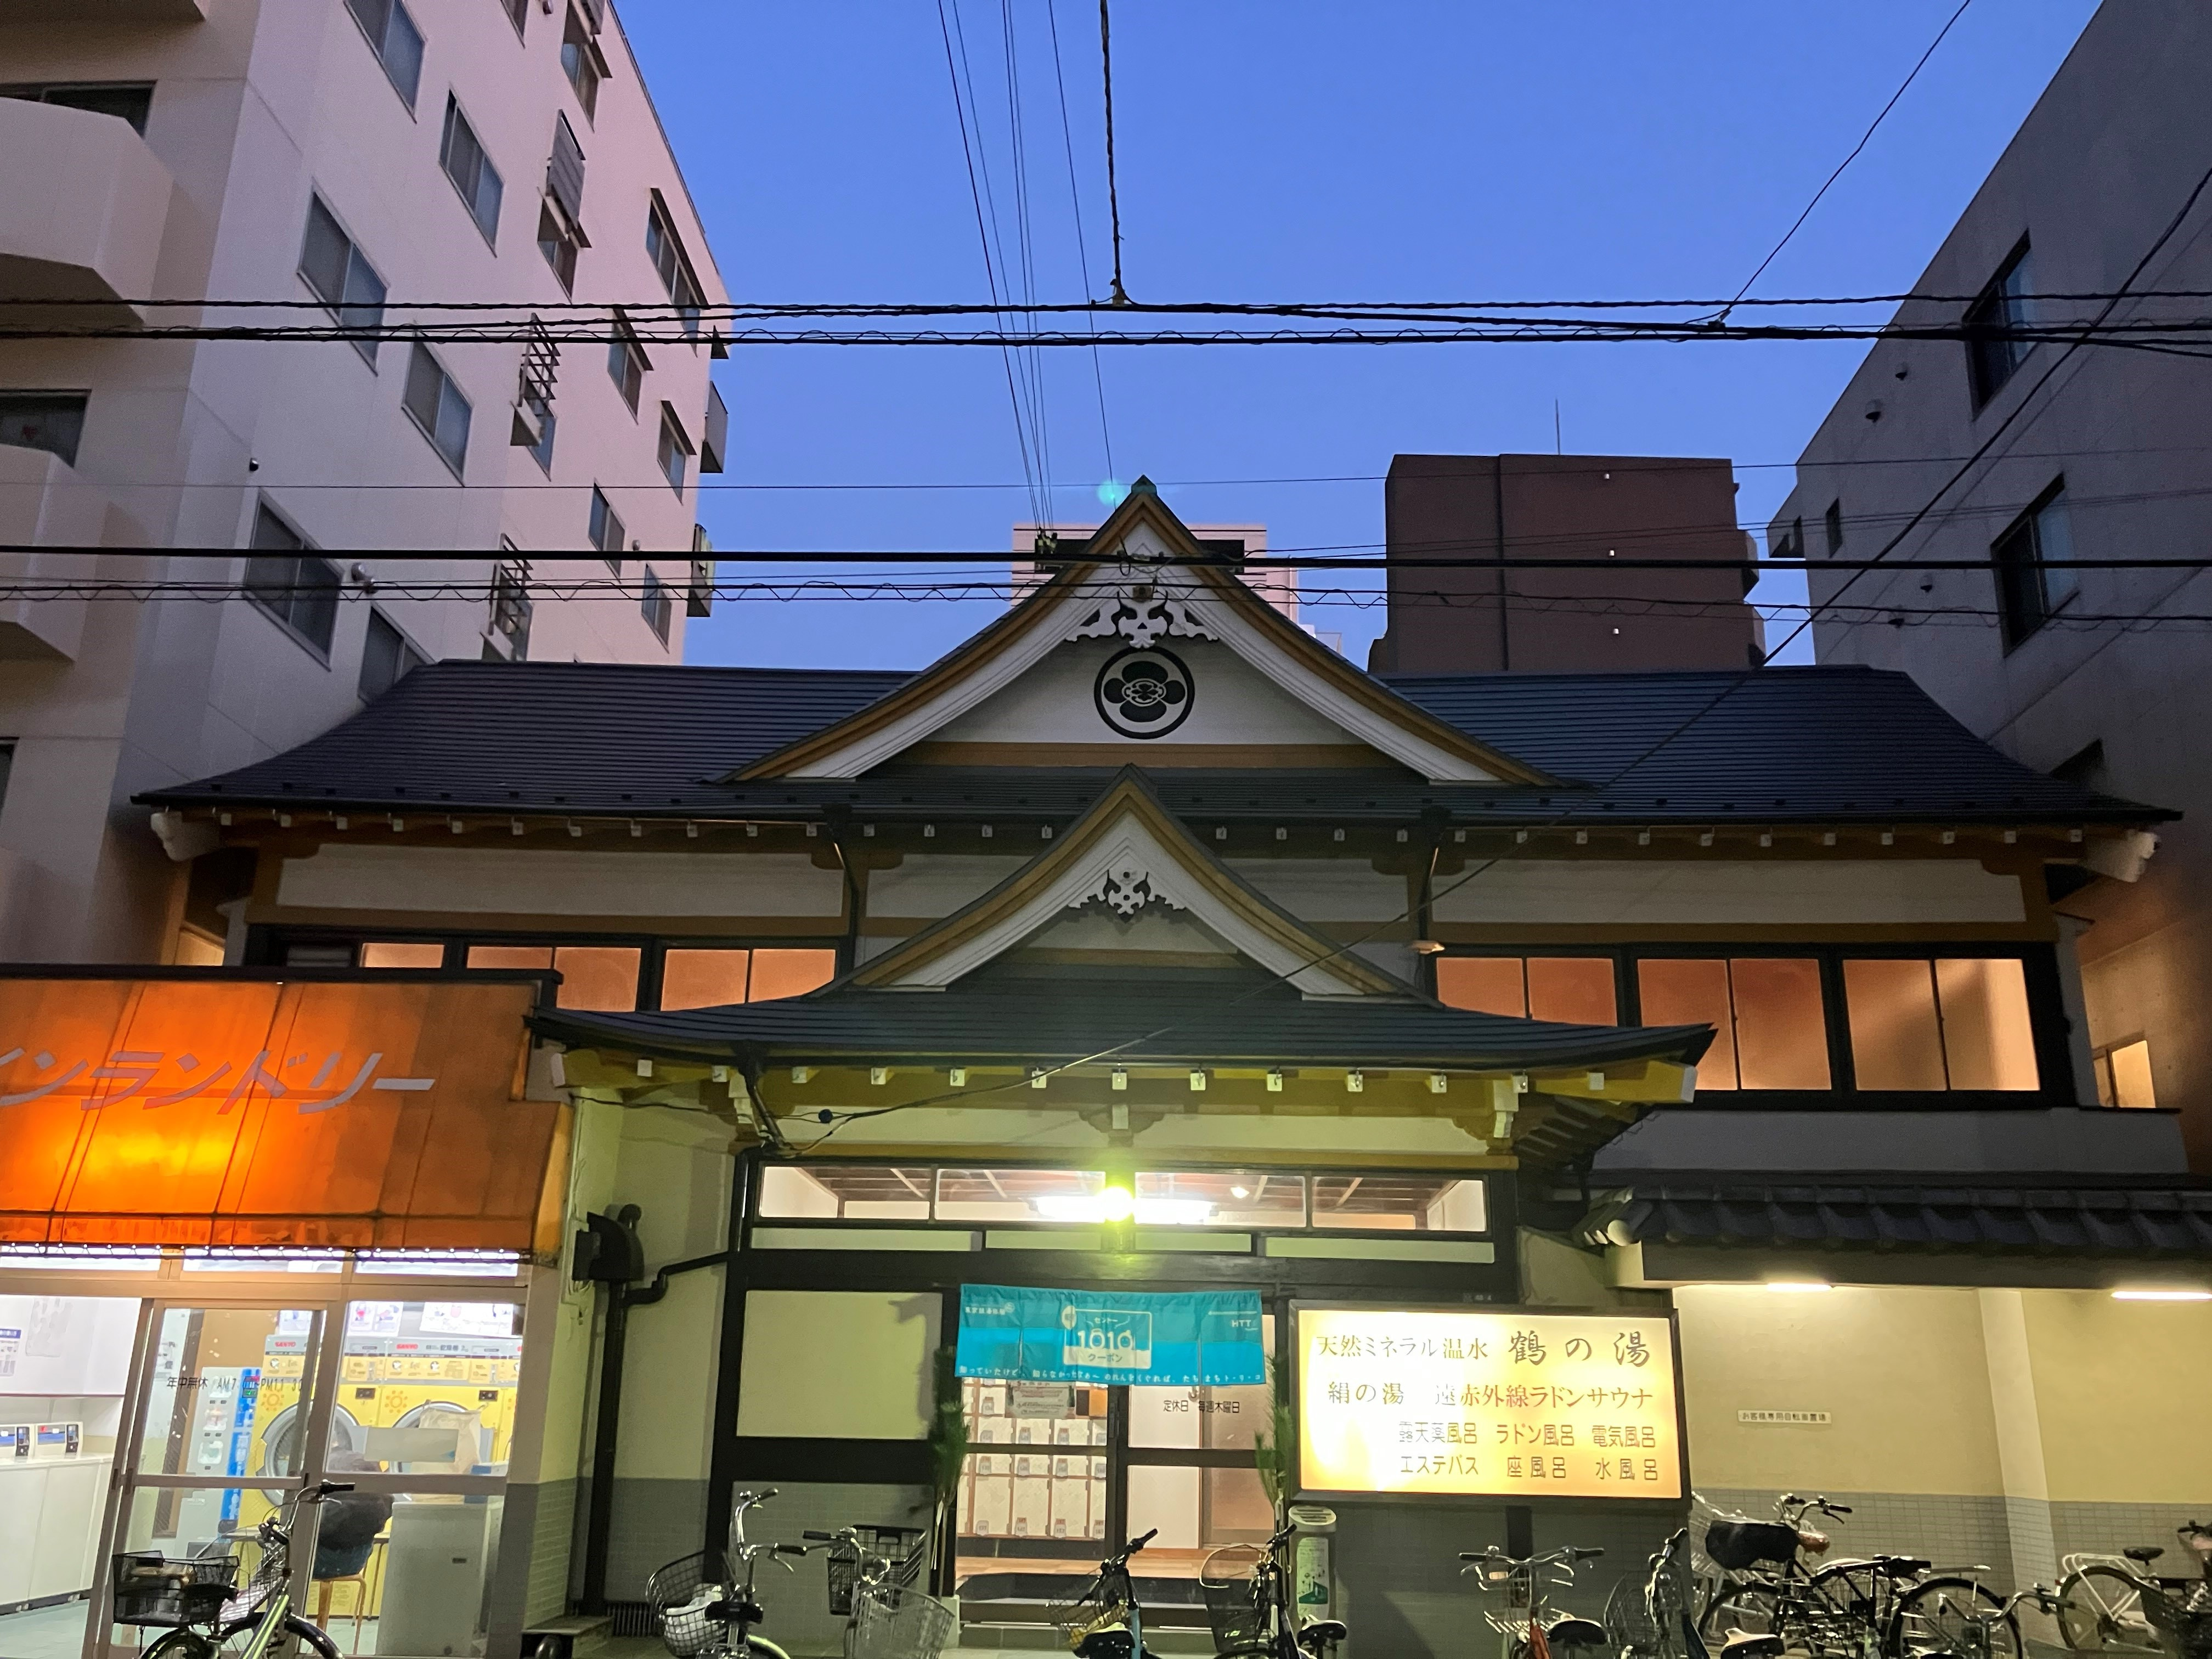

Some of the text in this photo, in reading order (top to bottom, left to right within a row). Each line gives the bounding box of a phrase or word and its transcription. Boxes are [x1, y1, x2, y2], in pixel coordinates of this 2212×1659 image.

[0, 1047, 436, 1115] ンランドリー
[1077, 1329, 1133, 1350] 1010
[1317, 1330, 1650, 1367] 天然ミネラル温水 鶴の湯
[1088, 1353, 1122, 1362] クーポン
[166, 1376, 208, 1390] 年中無休
[1328, 1381, 1654, 1410] 絹の湯 遠赤外線ラドンサウナ
[1163, 1400, 1240, 1413] 定休日 毎週木曜日
[1399, 1421, 1656, 1448] 露天薬風呂 ラドン風呂 電気風呂
[1506, 1456, 1566, 1479] 座風呂
[1595, 1458, 1658, 1481] 水風呂
